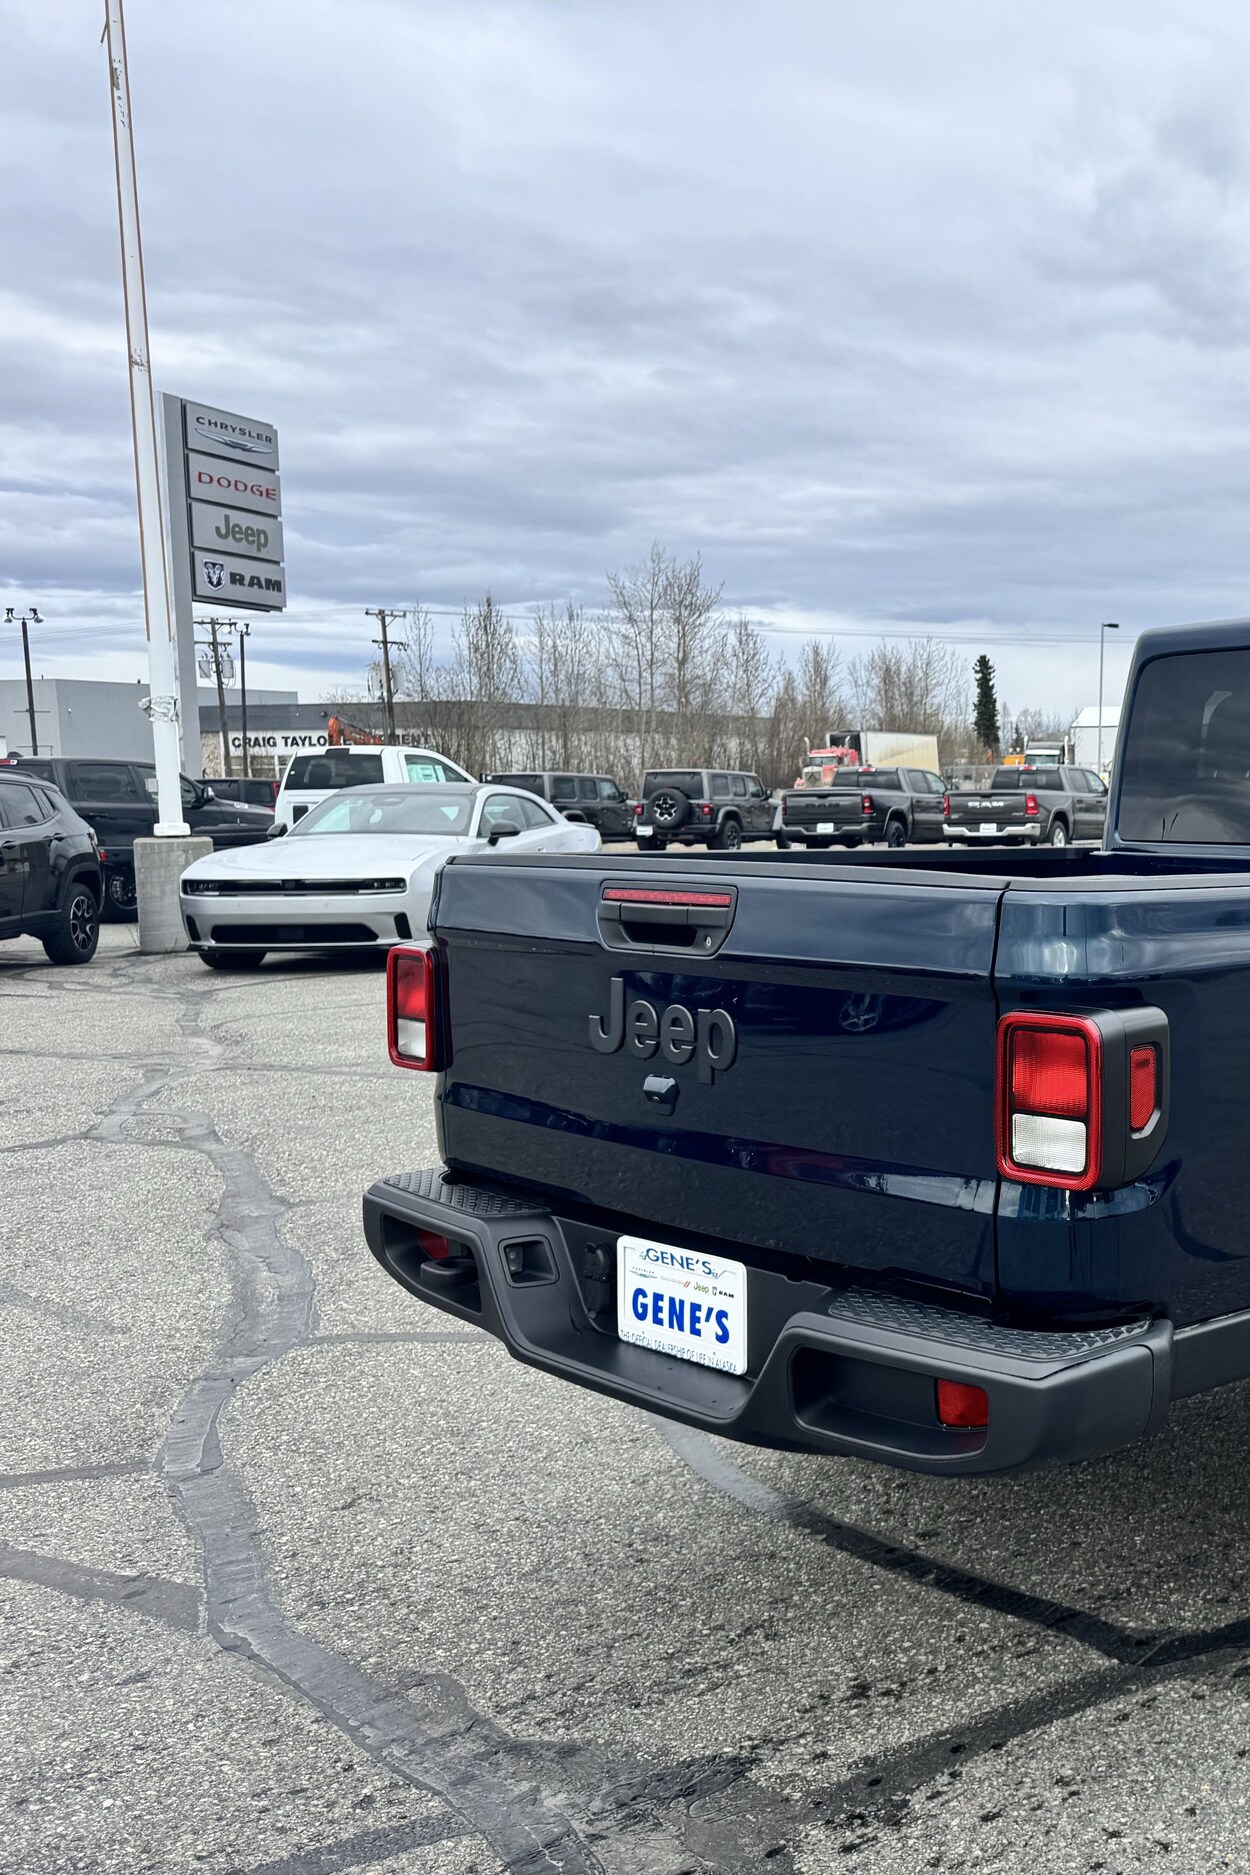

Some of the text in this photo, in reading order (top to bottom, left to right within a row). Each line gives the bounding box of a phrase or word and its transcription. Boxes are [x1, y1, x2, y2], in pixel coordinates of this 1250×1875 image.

[195, 416, 273, 444] CHRYSLER
[197, 471, 277, 501] DODGE
[214, 513, 269, 553] Jeep
[229, 571, 282, 593] RAM
[588, 977, 738, 1086] Jeep
[646, 1248, 712, 1275] GENE'S
[693, 1281, 710, 1295] Jeep
[718, 1290, 735, 1299] RAM
[632, 1287, 730, 1344] GENE'S
